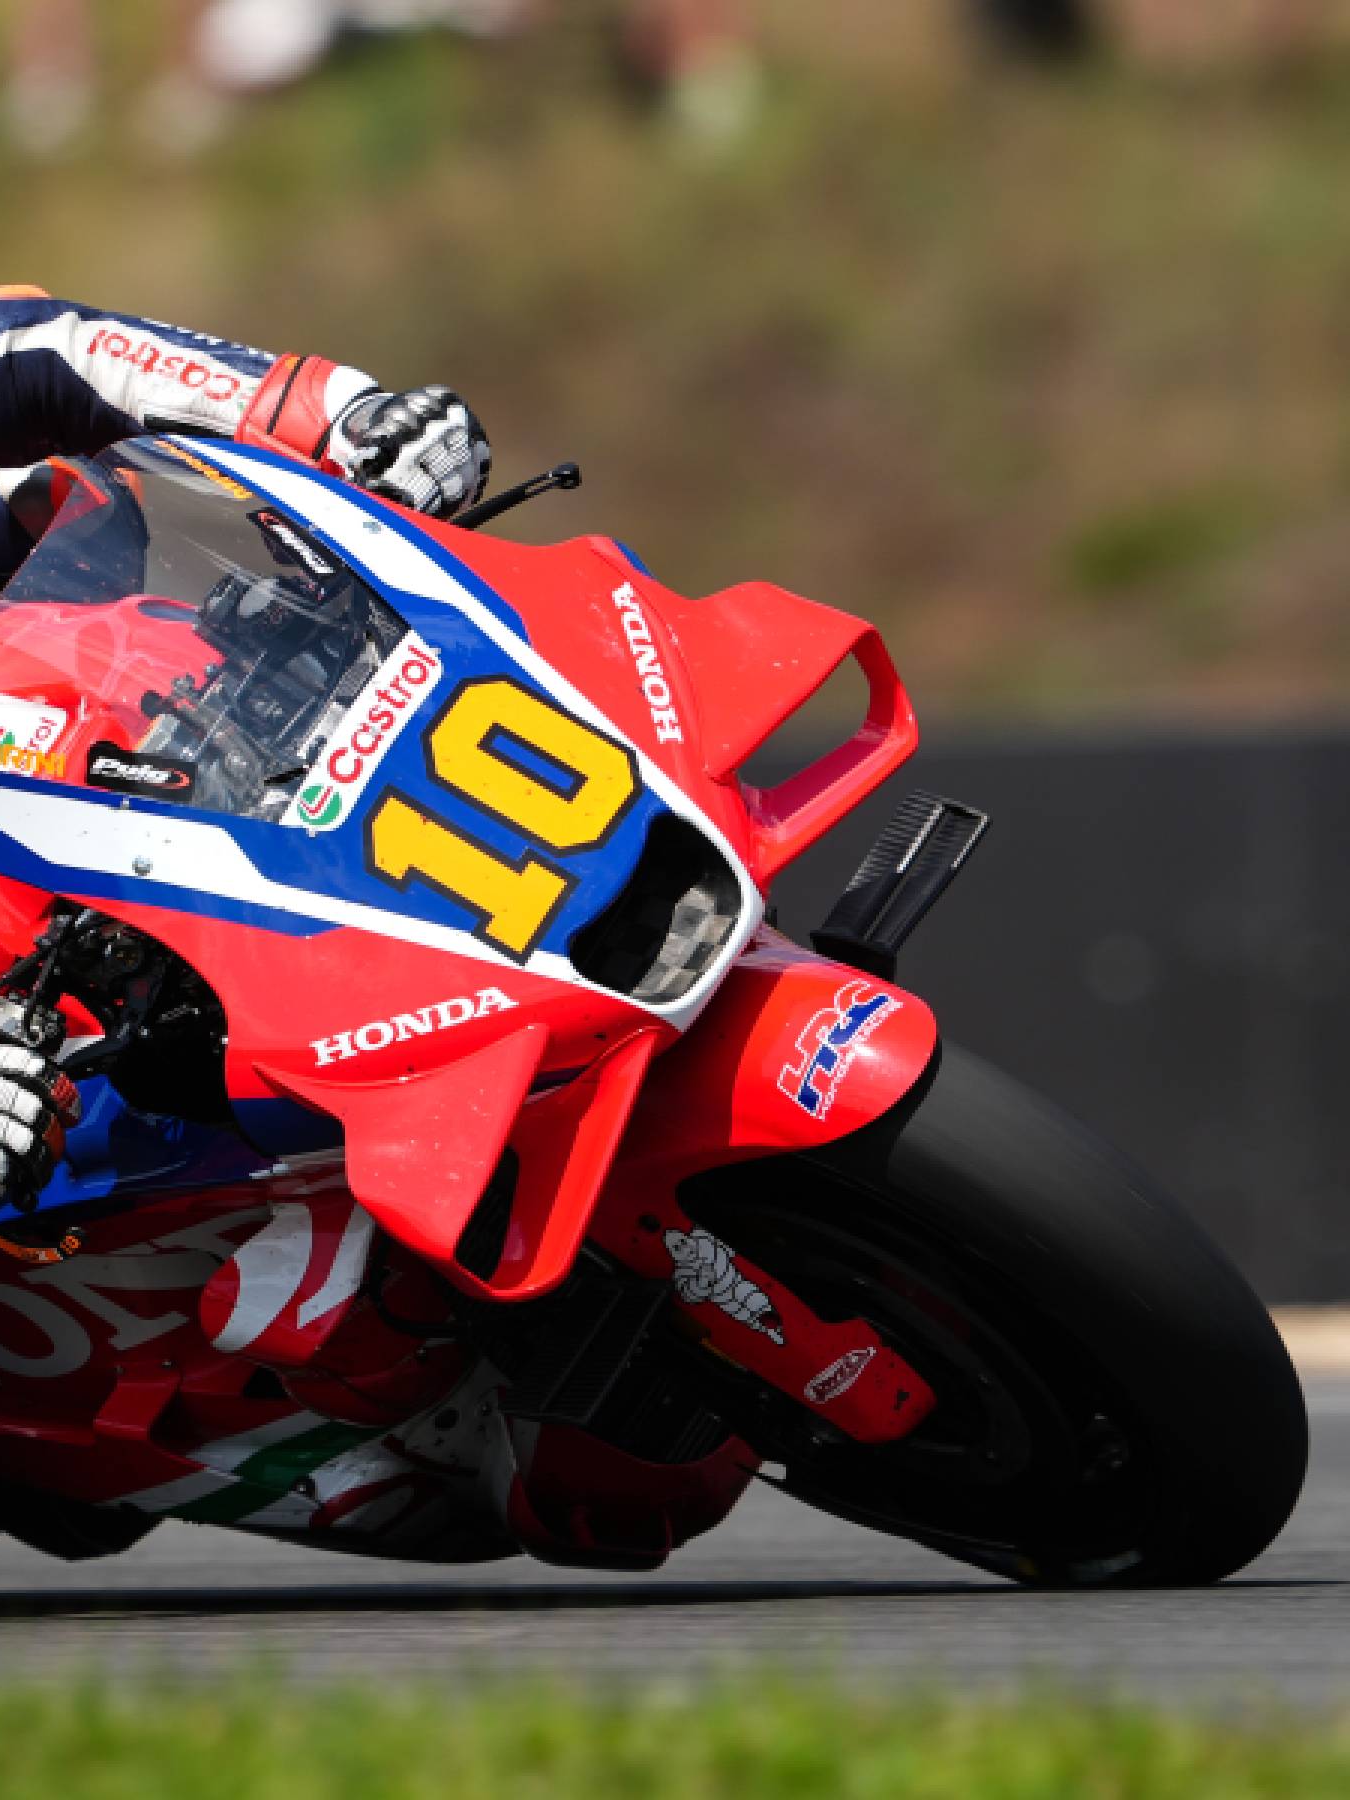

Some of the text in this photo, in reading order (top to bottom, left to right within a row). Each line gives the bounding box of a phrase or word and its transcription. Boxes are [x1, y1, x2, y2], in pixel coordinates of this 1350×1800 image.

[326, 644, 439, 785] Castrol
[611, 581, 684, 744] HONDA
[363, 673, 646, 965] 10
[309, 986, 520, 1067] HONDA
